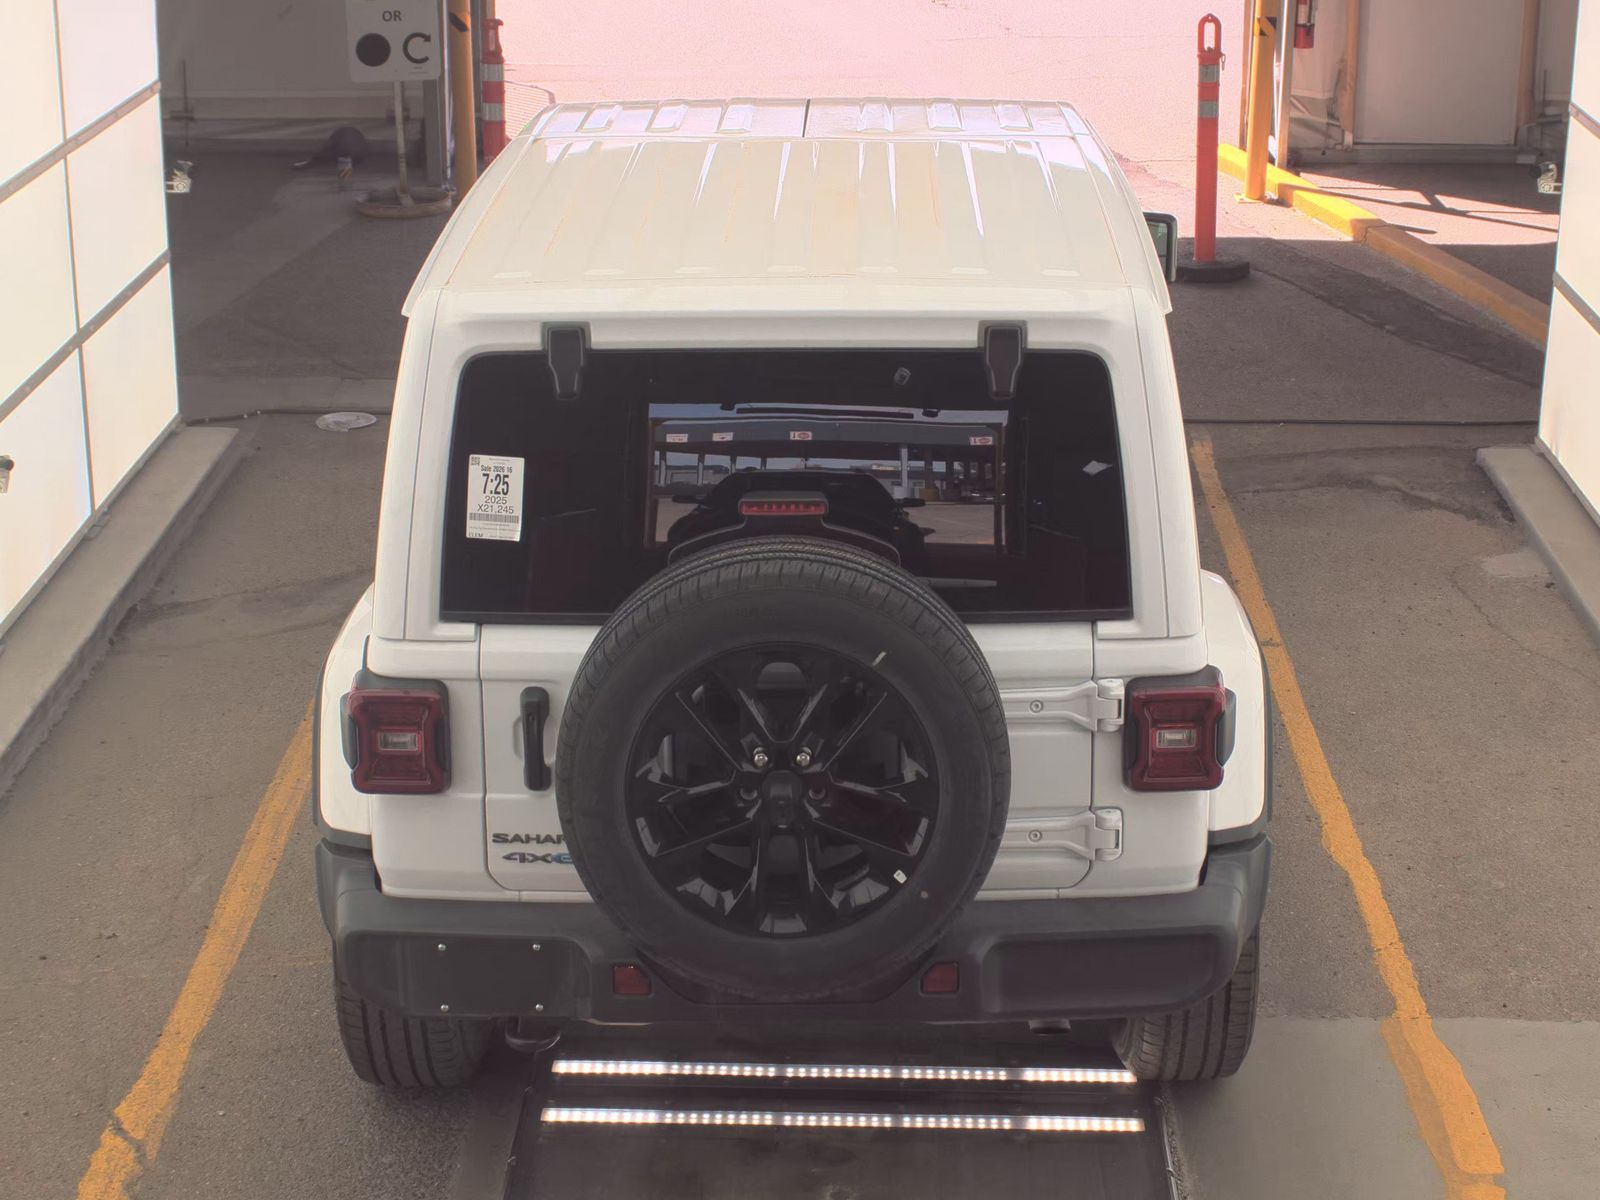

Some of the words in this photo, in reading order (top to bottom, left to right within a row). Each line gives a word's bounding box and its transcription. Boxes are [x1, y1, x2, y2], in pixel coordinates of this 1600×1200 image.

[382, 10, 402, 22] OR
[480, 464, 492, 473] Sale
[482, 473, 510, 496] 7:25
[484, 495, 508, 505] 2025
